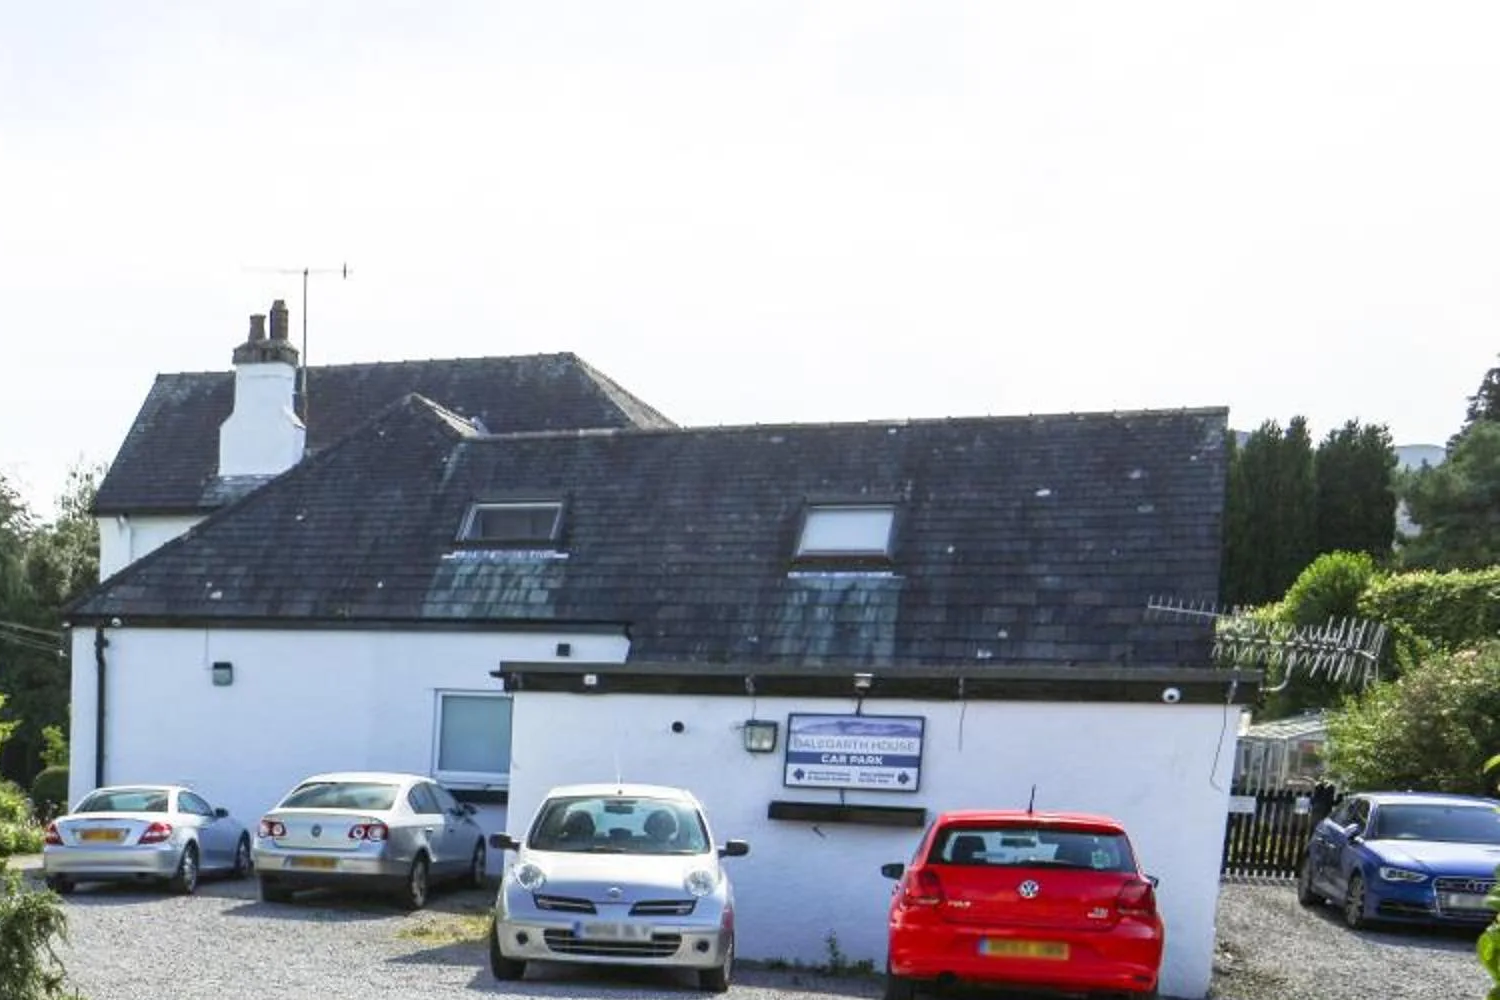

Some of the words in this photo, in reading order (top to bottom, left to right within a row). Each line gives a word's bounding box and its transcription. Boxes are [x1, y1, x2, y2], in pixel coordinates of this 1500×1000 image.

[871, 740, 915, 751] HOUSE
[821, 753, 846, 764] CAR
[849, 755, 883, 765] PARK
